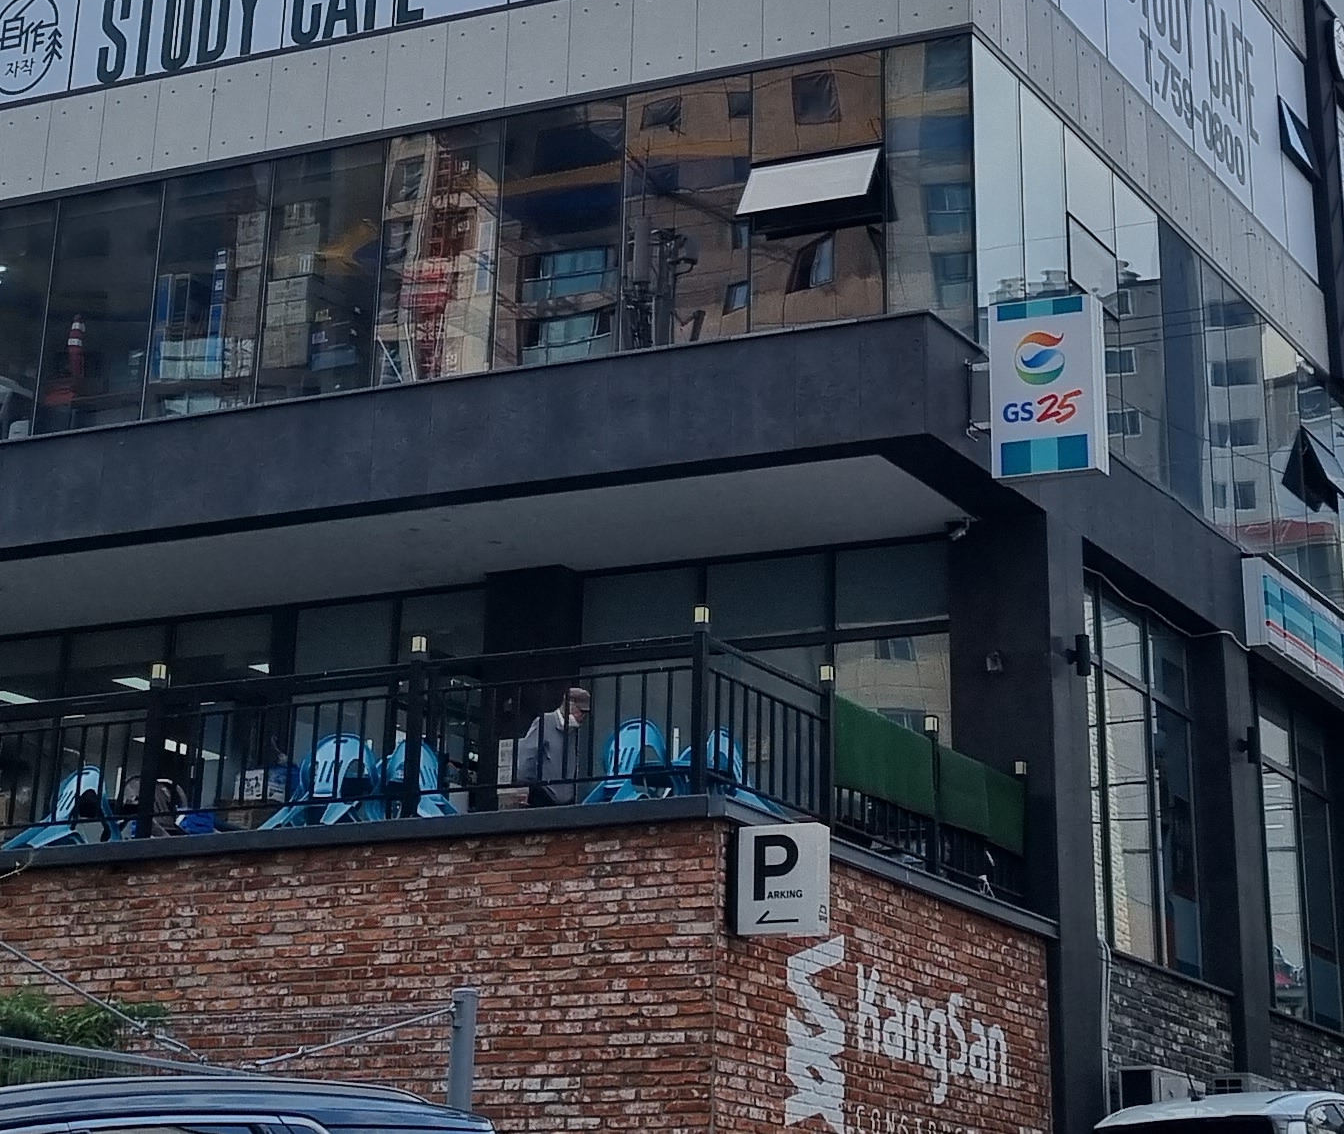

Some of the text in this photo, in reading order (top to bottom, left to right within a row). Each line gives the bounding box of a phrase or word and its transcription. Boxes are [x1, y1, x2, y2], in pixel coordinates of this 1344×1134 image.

[4, 59, 36, 79] 자작
[1139, 27, 1246, 187] T.759-0800
[1002, 388, 1083, 425] GS25
